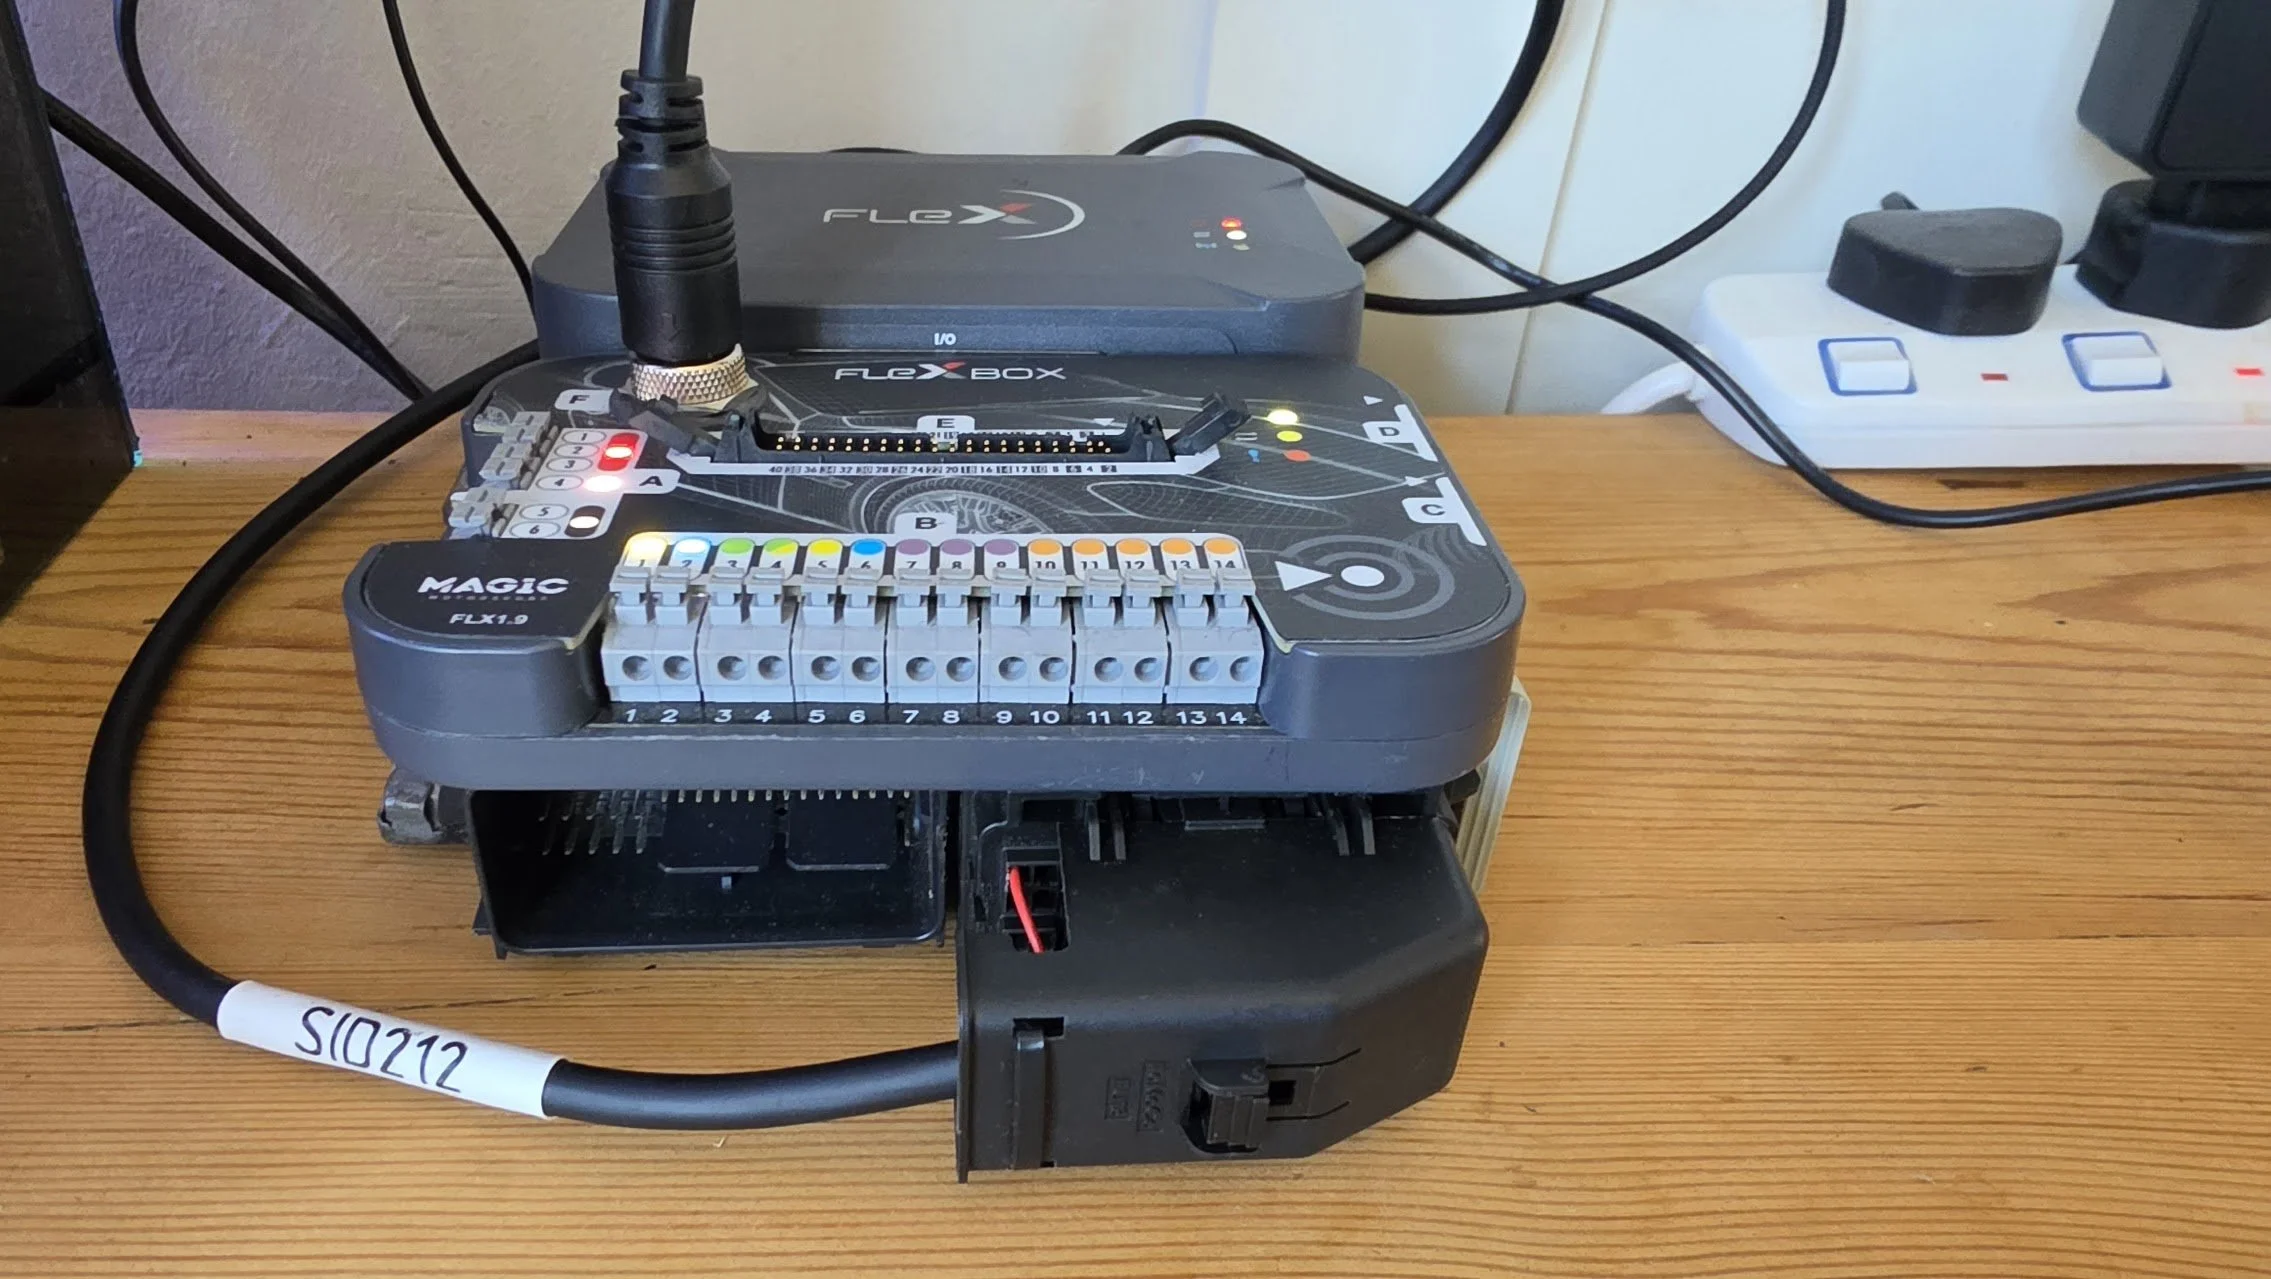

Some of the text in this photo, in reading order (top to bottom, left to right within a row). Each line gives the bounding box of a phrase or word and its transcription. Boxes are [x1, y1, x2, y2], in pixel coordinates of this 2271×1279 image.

[934, 332, 957, 346] I/O
[970, 366, 1067, 381] BOX
[568, 394, 591, 405] F
[936, 417, 956, 429] E
[580, 432, 588, 441] 1
[1379, 426, 1400, 437] D
[572, 446, 583, 455] 2
[564, 460, 575, 469] 3
[553, 477, 565, 487] 4
[639, 475, 664, 487] A
[538, 506, 550, 517] 5
[1421, 504, 1446, 516] C
[915, 517, 938, 530] B
[529, 524, 540, 535] 6
[1214, 561, 1236, 570] 14
[449, 613, 529, 625] FLX1.9
[625, 709, 1247, 724] 1 2 3 4 5 6 7 8 9 10 11 12 13 14
